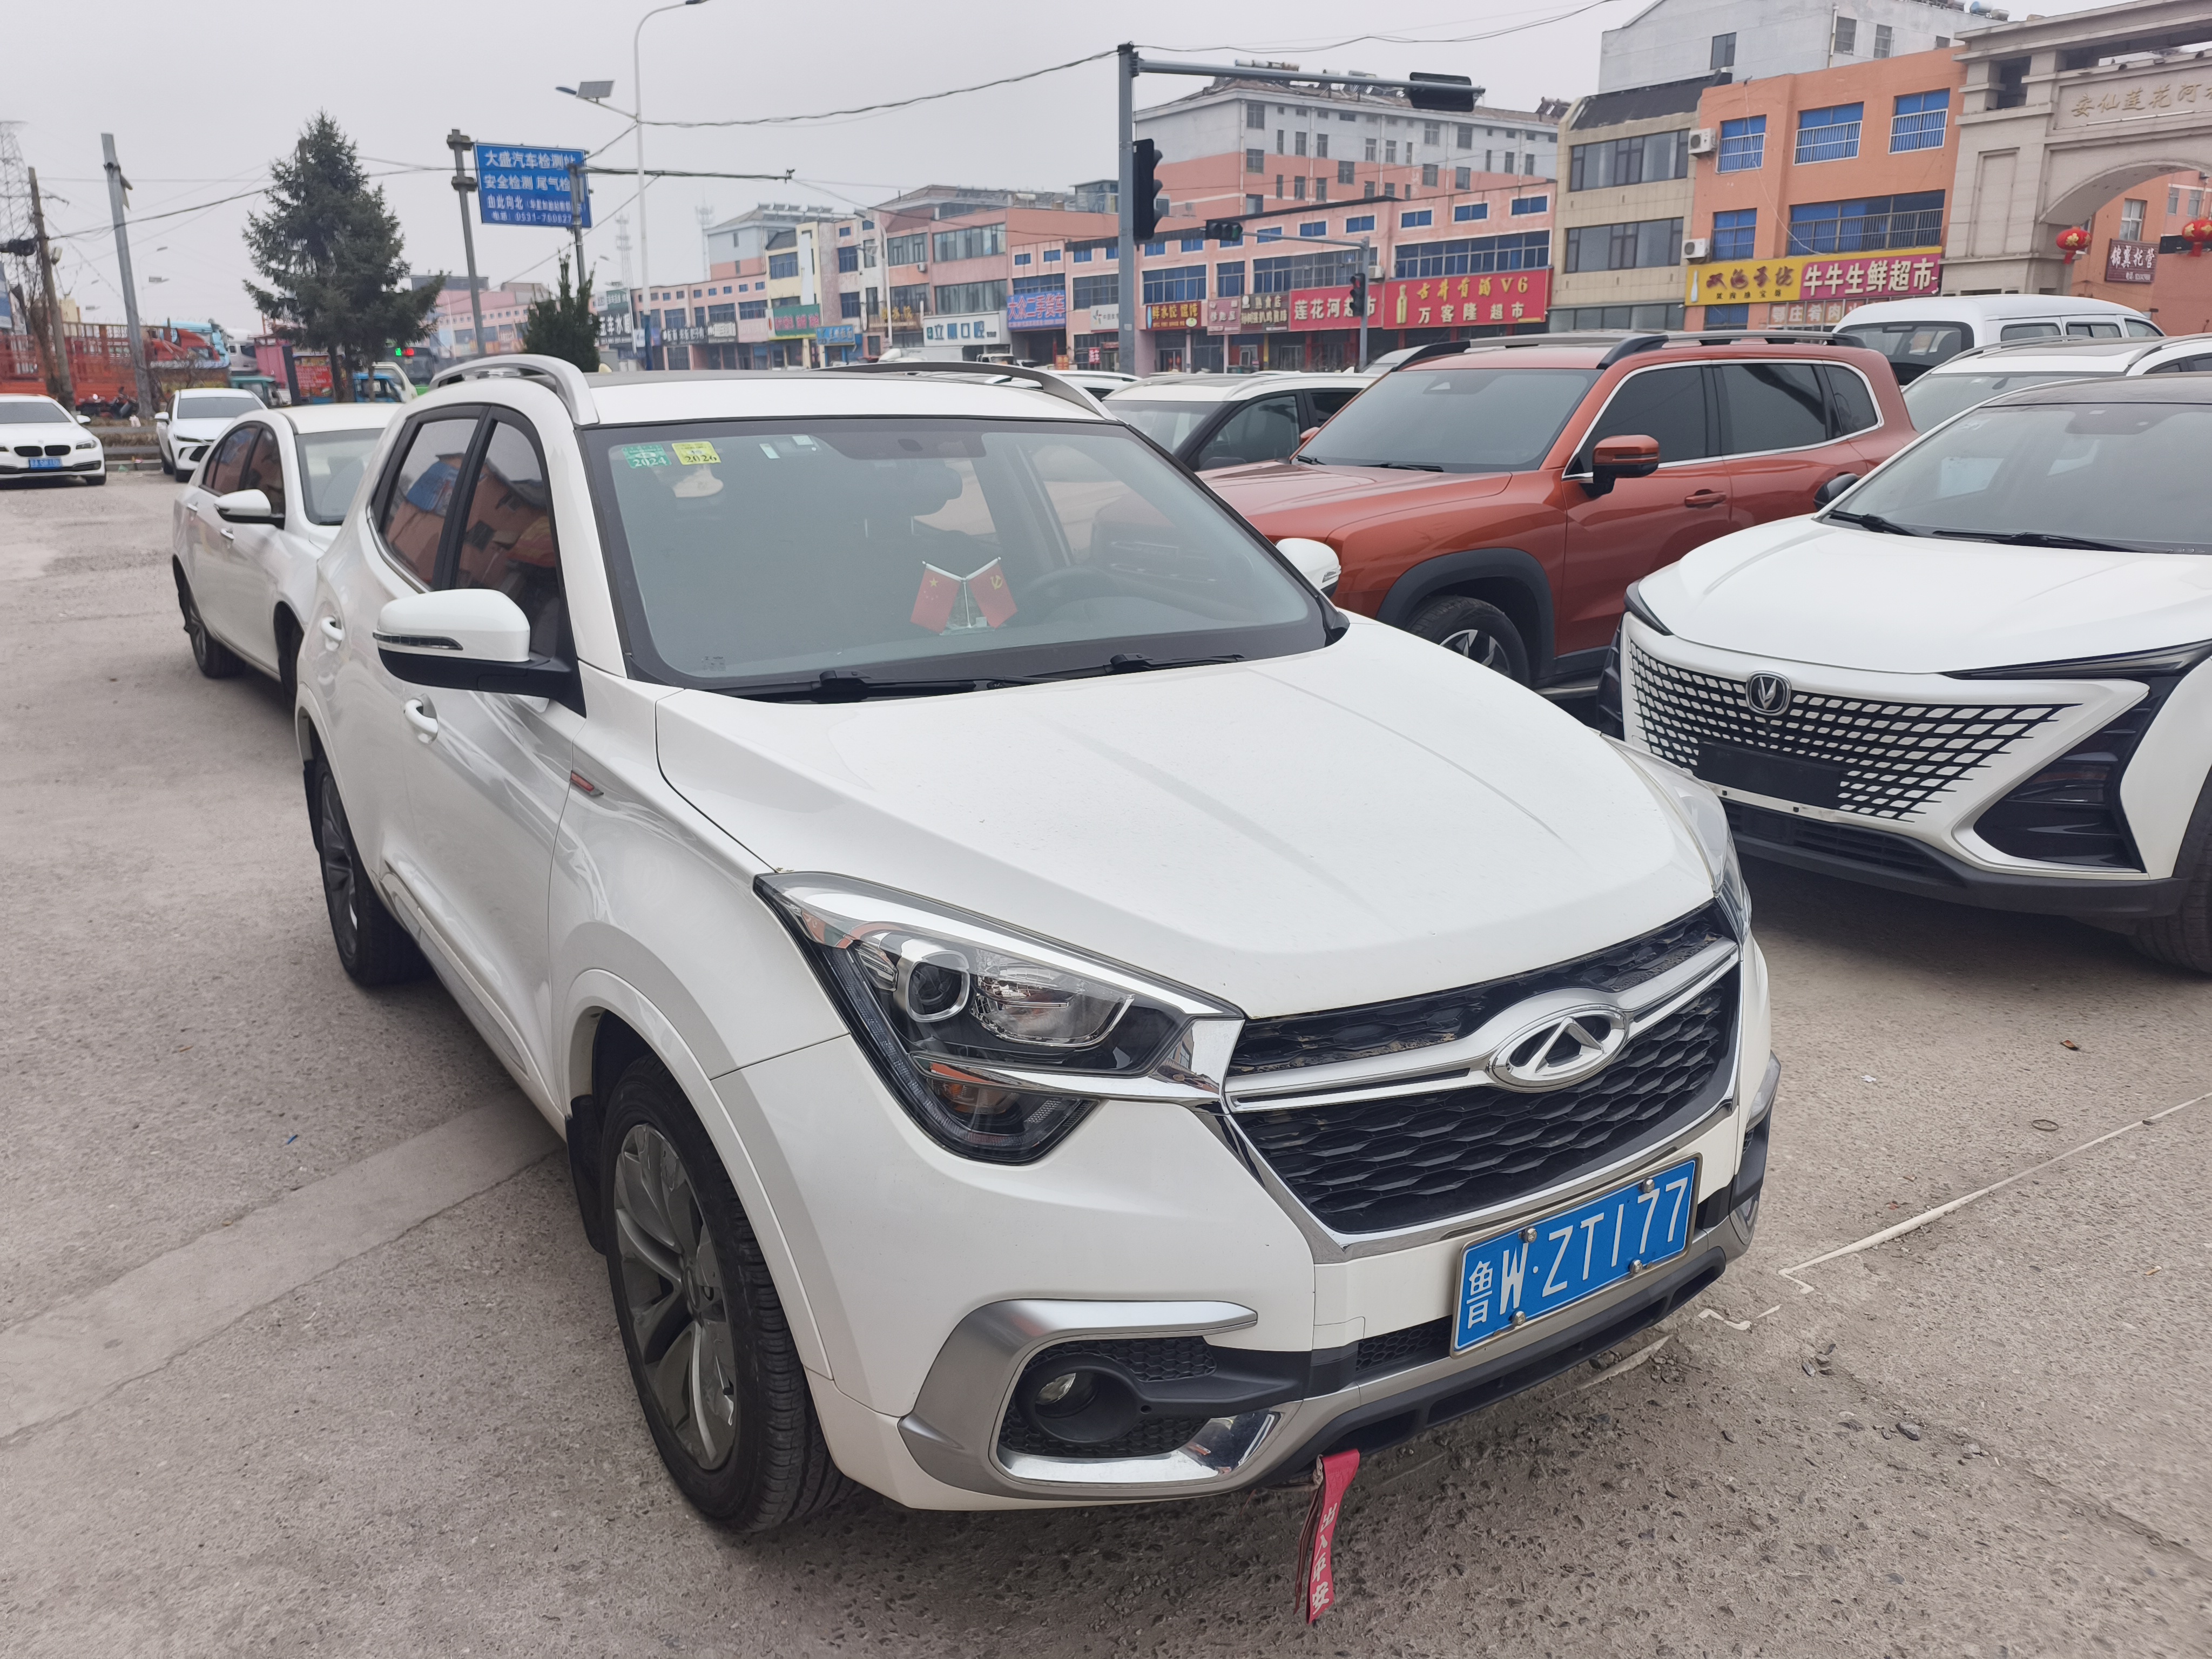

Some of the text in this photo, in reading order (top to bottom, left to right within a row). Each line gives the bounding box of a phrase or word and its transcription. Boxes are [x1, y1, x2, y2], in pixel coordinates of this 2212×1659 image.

[484, 173, 572, 192] 安全检测 尾气检
[1803, 257, 1935, 297] 牛牛生鲜超市
[1008, 292, 1066, 320] 大众二手货车
[1418, 300, 1526, 325] 万客隆超市
[632, 456, 666, 467] 2024
[1312, 1502, 1338, 1615] 出入平安
